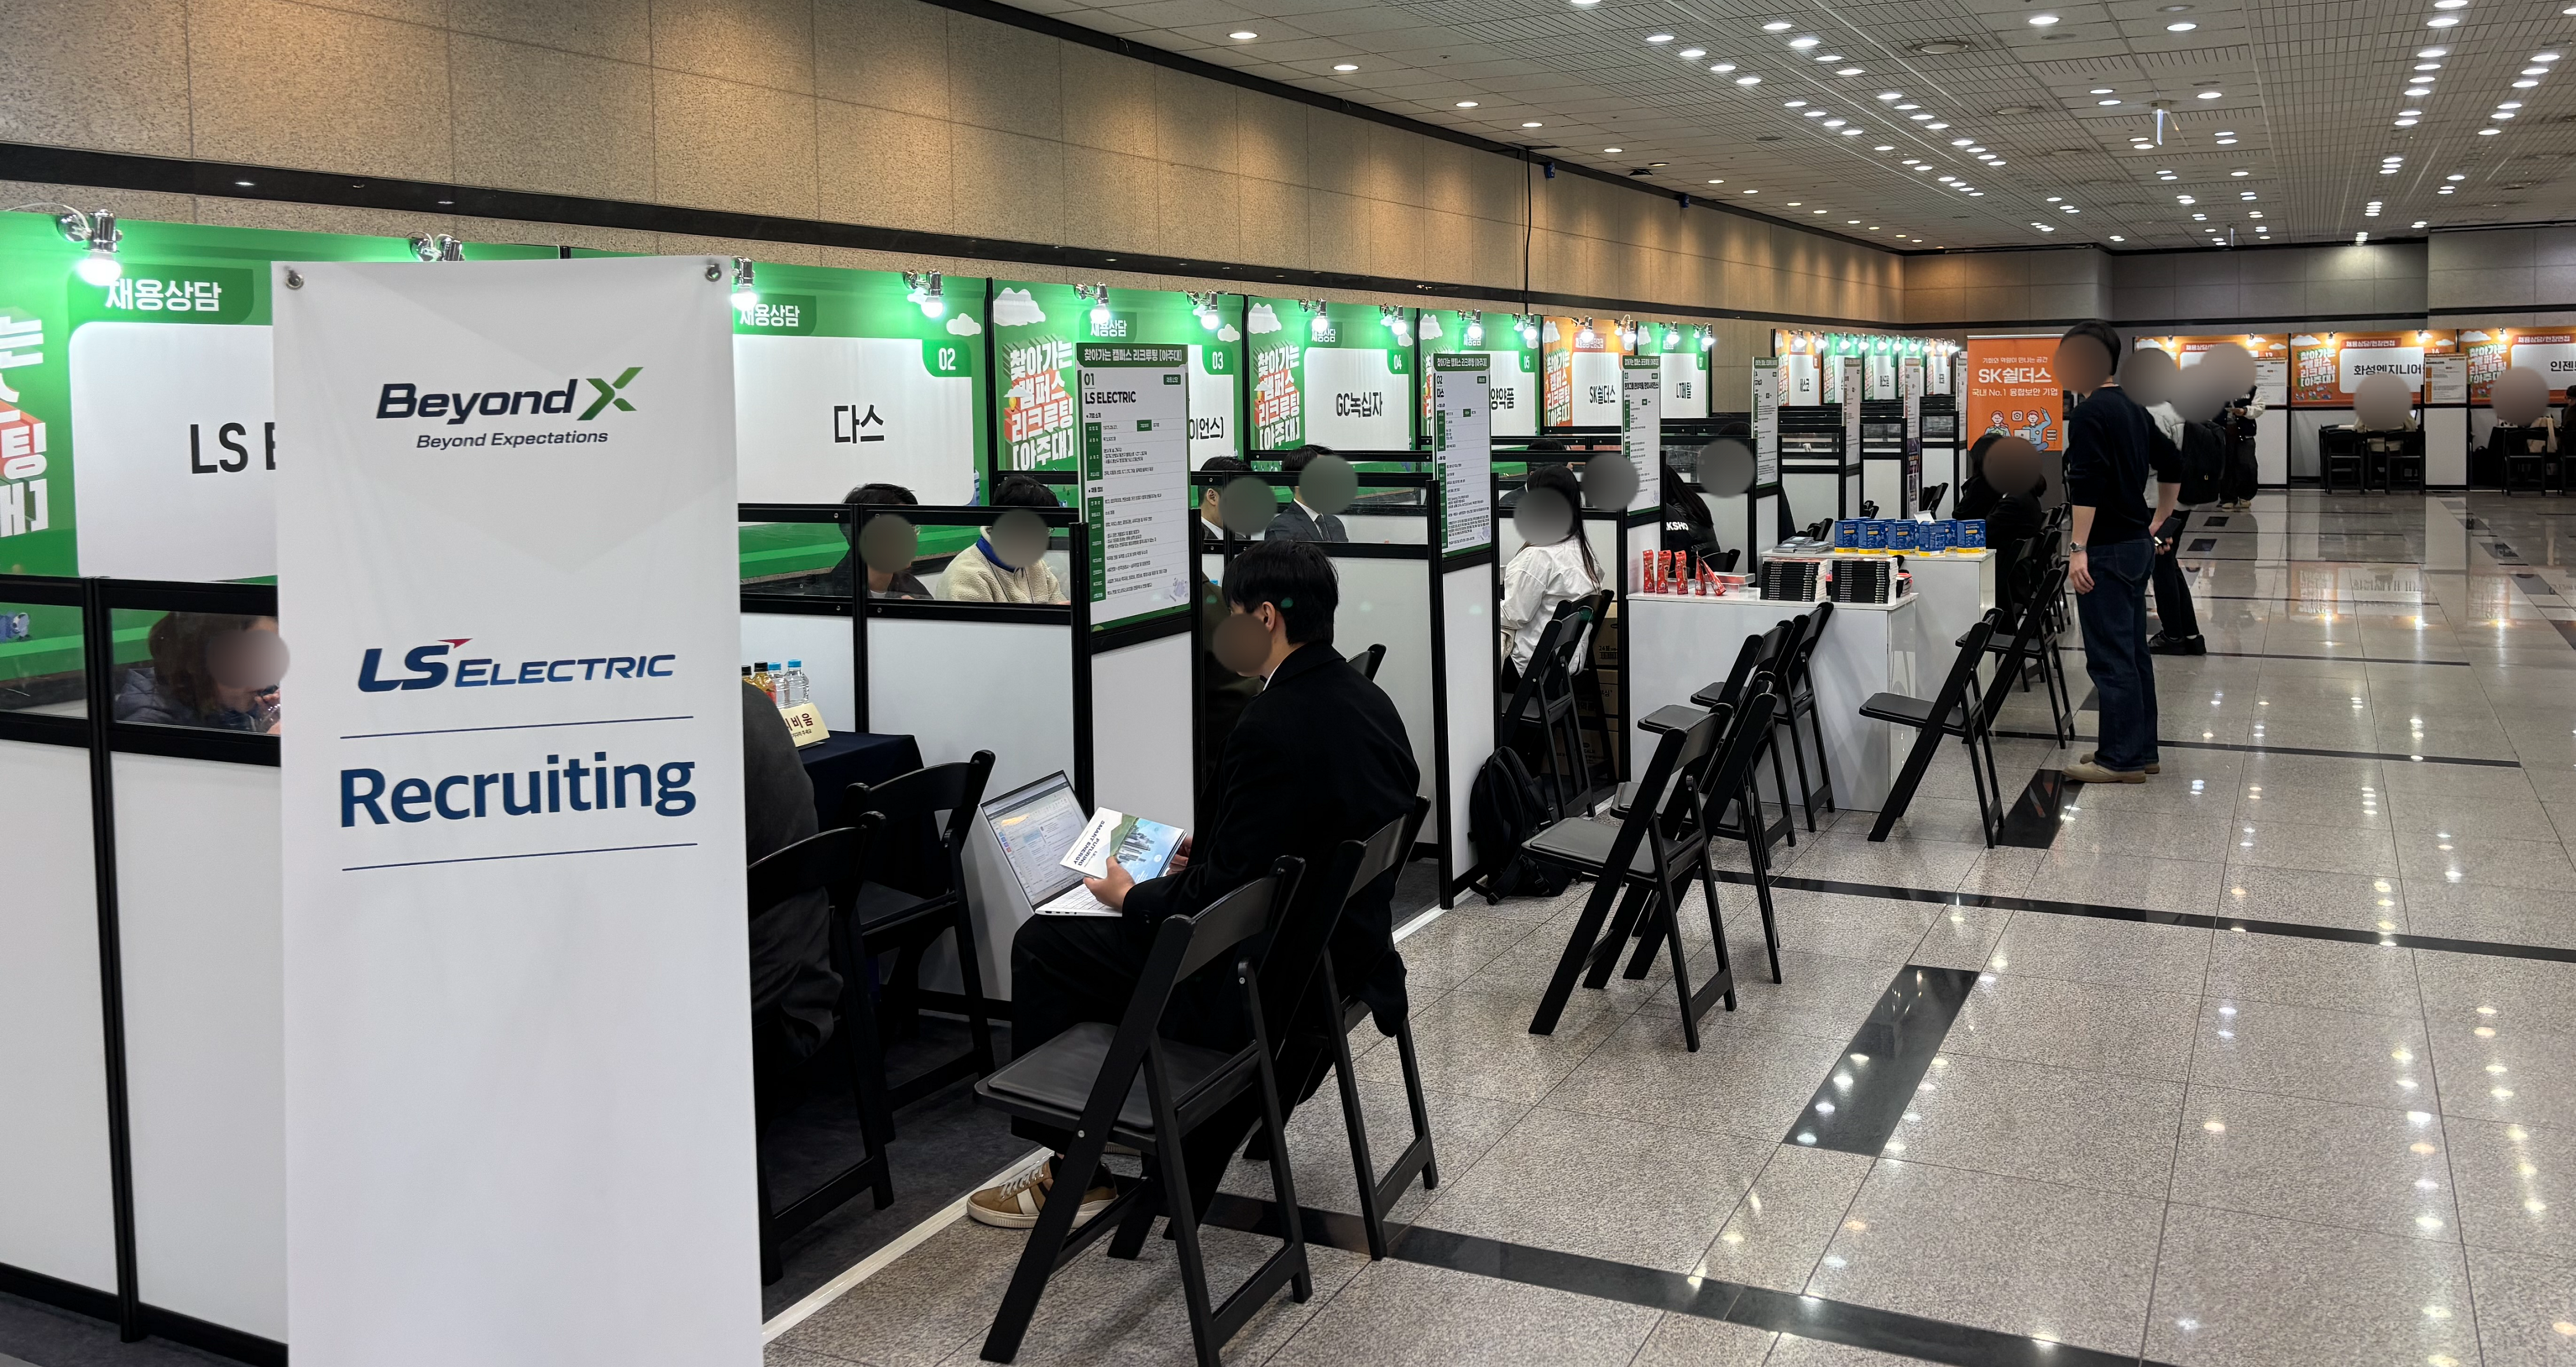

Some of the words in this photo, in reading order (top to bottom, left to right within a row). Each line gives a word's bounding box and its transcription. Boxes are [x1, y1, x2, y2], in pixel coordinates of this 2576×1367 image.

[938, 347, 956, 371] 02
[1010, 340, 1073, 381] 찾아가는
[1212, 351, 1224, 370] 03
[1258, 345, 1300, 377] 찾아가는
[1394, 354, 1402, 370] 04
[2550, 361, 2576, 372] 인젠
[1084, 373, 1095, 386] 01
[1978, 367, 2052, 384] SK쉴더스
[1085, 391, 1095, 405] LS
[1097, 391, 1137, 404] ELECTRIC
[1989, 388, 2006, 397] No.1
[1258, 391, 1300, 427] 리크루팅
[1336, 391, 1383, 418] GC녹십자
[833, 404, 885, 444] 다스
[1011, 397, 1073, 443] 리크루팅
[191, 423, 249, 474] LS
[416, 432, 485, 450] Beyond
[490, 428, 608, 449] Expectations
[357, 643, 451, 693] LS
[454, 653, 676, 688] ELECTRIC
[785, 713, 814, 731] 비움
[340, 751, 696, 828] Recruiting
[1090, 820, 1105, 842] SMART
